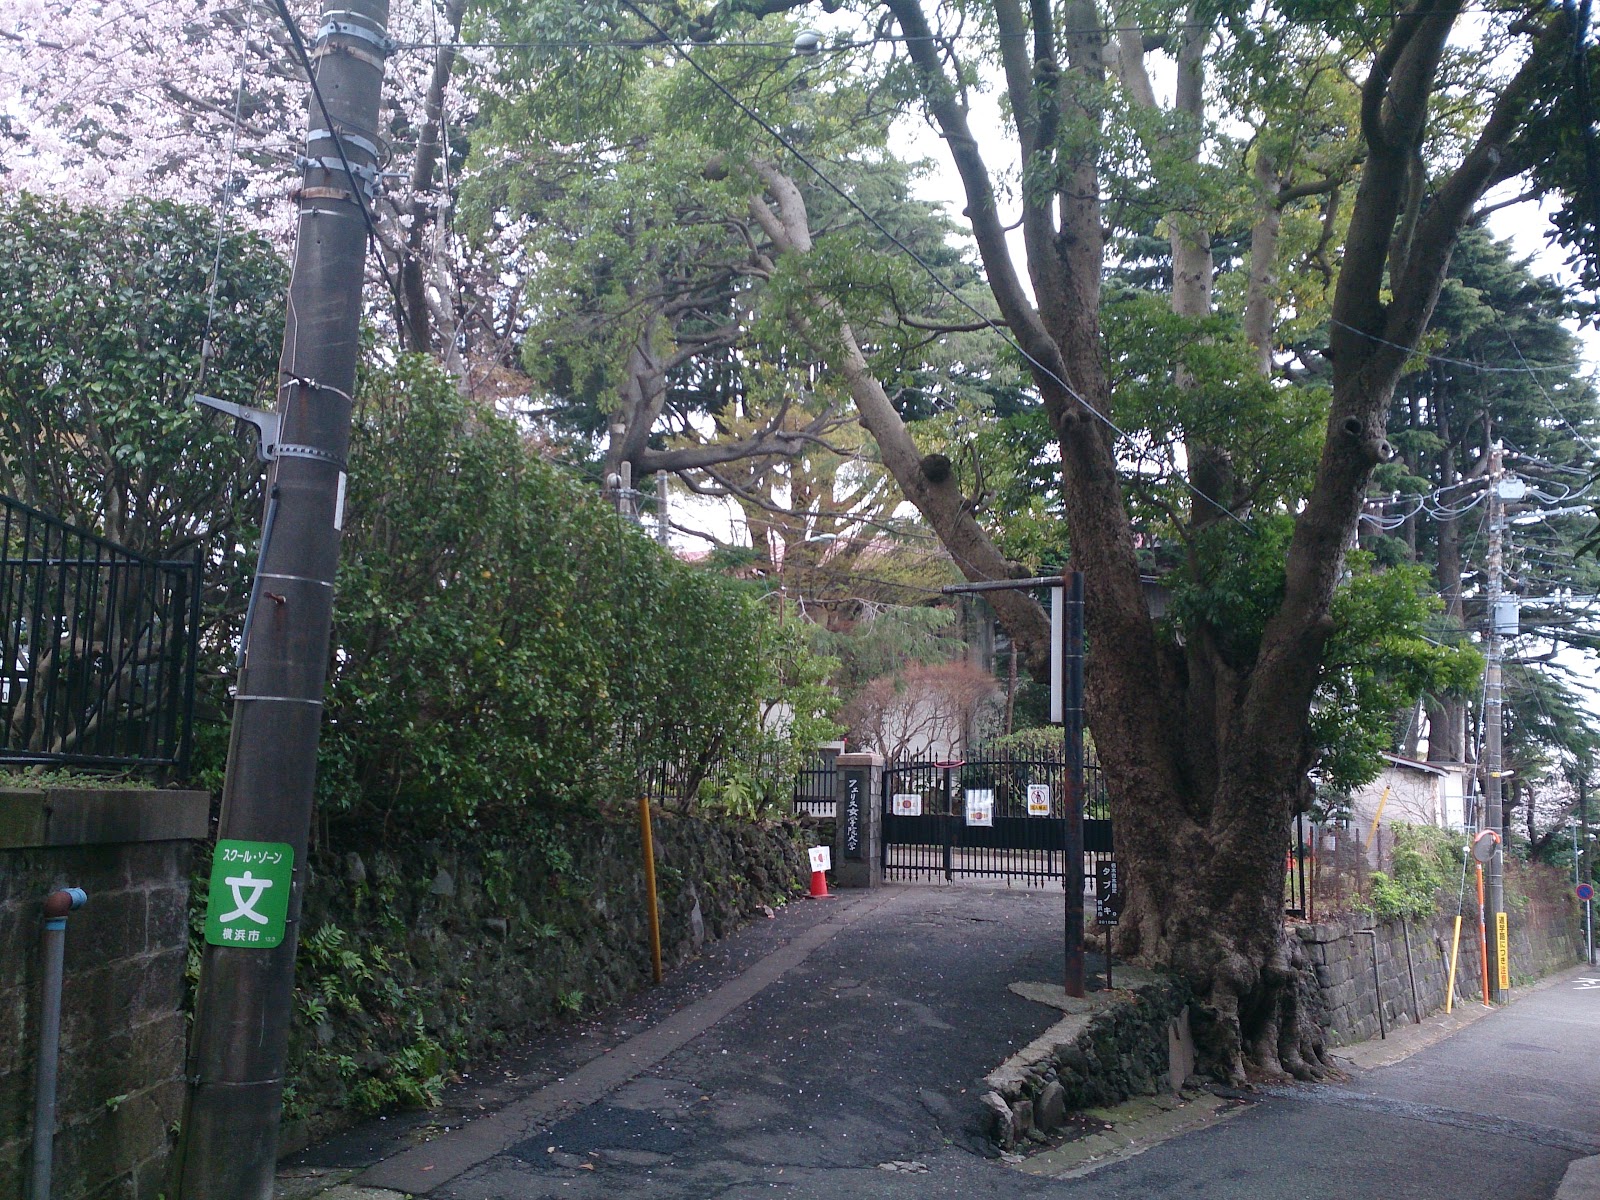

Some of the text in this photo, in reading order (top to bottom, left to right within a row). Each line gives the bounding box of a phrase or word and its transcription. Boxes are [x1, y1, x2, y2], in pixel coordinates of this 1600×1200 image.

[847, 779, 859, 851] フェリス女学院大学
[222, 848, 282, 864] スクール・ゾーン
[219, 870, 273, 925] 文
[1103, 867, 1111, 915] タブノキ
[222, 928, 260, 942] 横浜市
